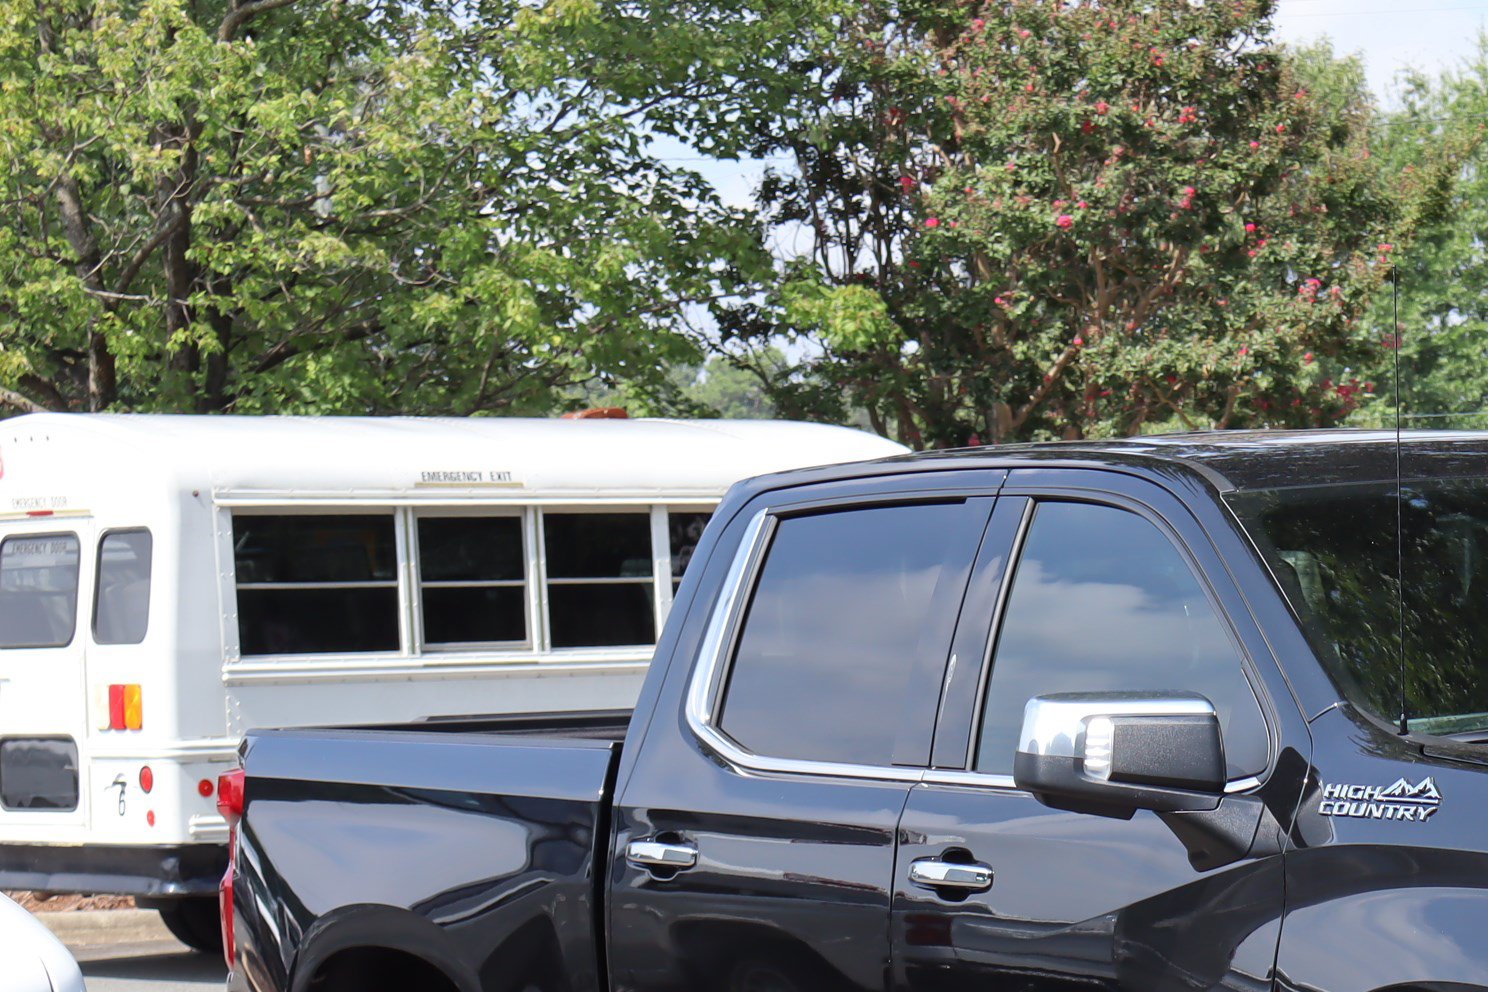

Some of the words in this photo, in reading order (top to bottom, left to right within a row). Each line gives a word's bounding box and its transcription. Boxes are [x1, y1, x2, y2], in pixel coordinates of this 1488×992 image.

[421, 471, 482, 482] EMERGENCY
[490, 471, 512, 482] EXIT
[1323, 783, 1382, 800] HIGH
[1318, 801, 1438, 822] COUNTRY
